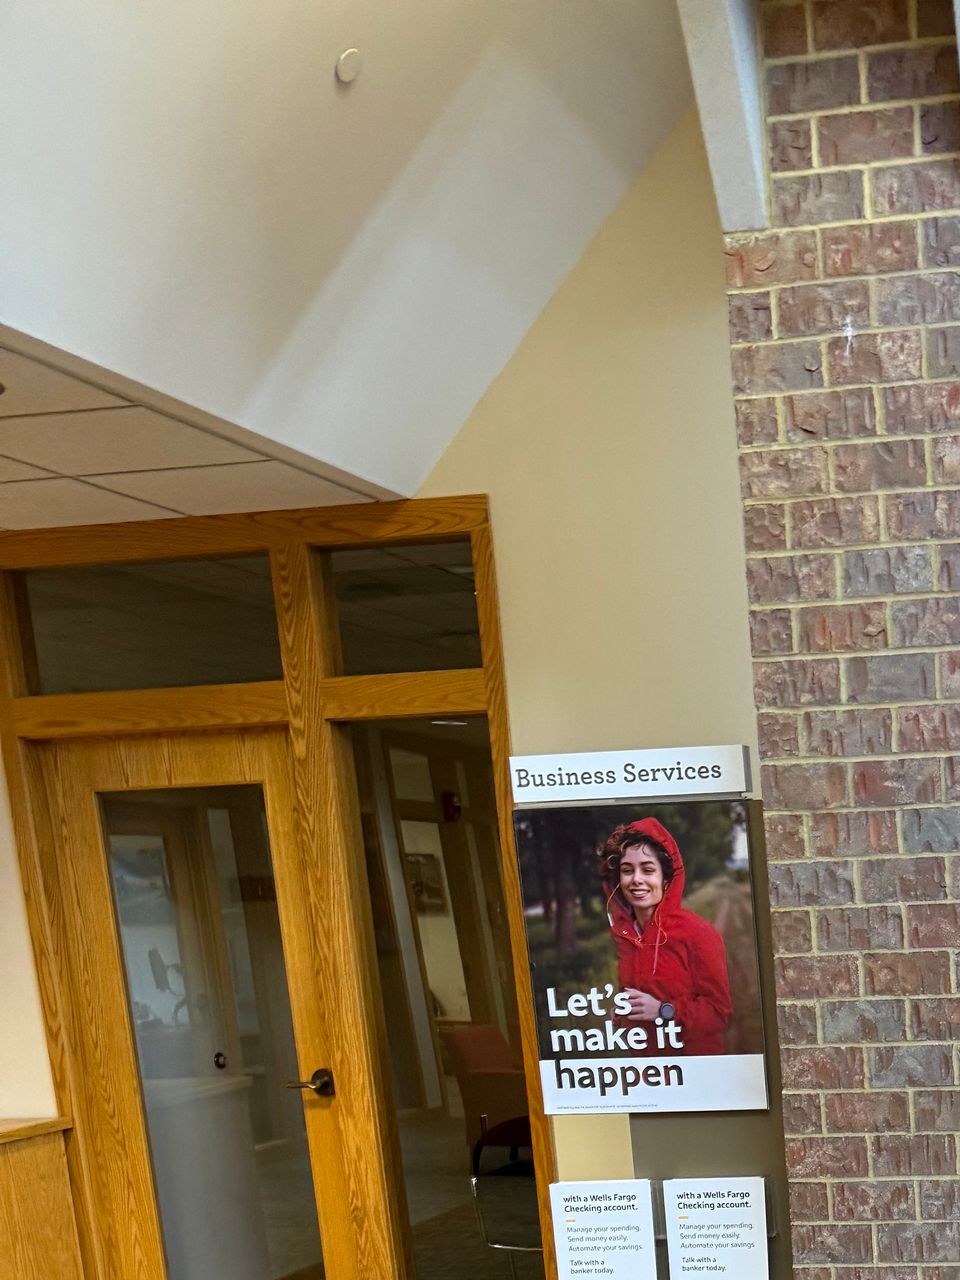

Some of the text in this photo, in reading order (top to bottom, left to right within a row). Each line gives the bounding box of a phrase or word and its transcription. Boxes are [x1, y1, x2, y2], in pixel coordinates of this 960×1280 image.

[515, 761, 721, 788] Business Services
[547, 984, 632, 1017] Let’s
[550, 1017, 684, 1052] make it
[555, 1060, 684, 1096] happen
[563, 1194, 581, 1203] with
[590, 1194, 612, 1202] Wells
[614, 1194, 636, 1202] Fargo
[677, 1191, 695, 1199] with
[727, 1191, 750, 1199] Fargo
[564, 1203, 638, 1213] Checking account.
[677, 1202, 714, 1210] Checking
[585, 1236, 607, 1244] money
